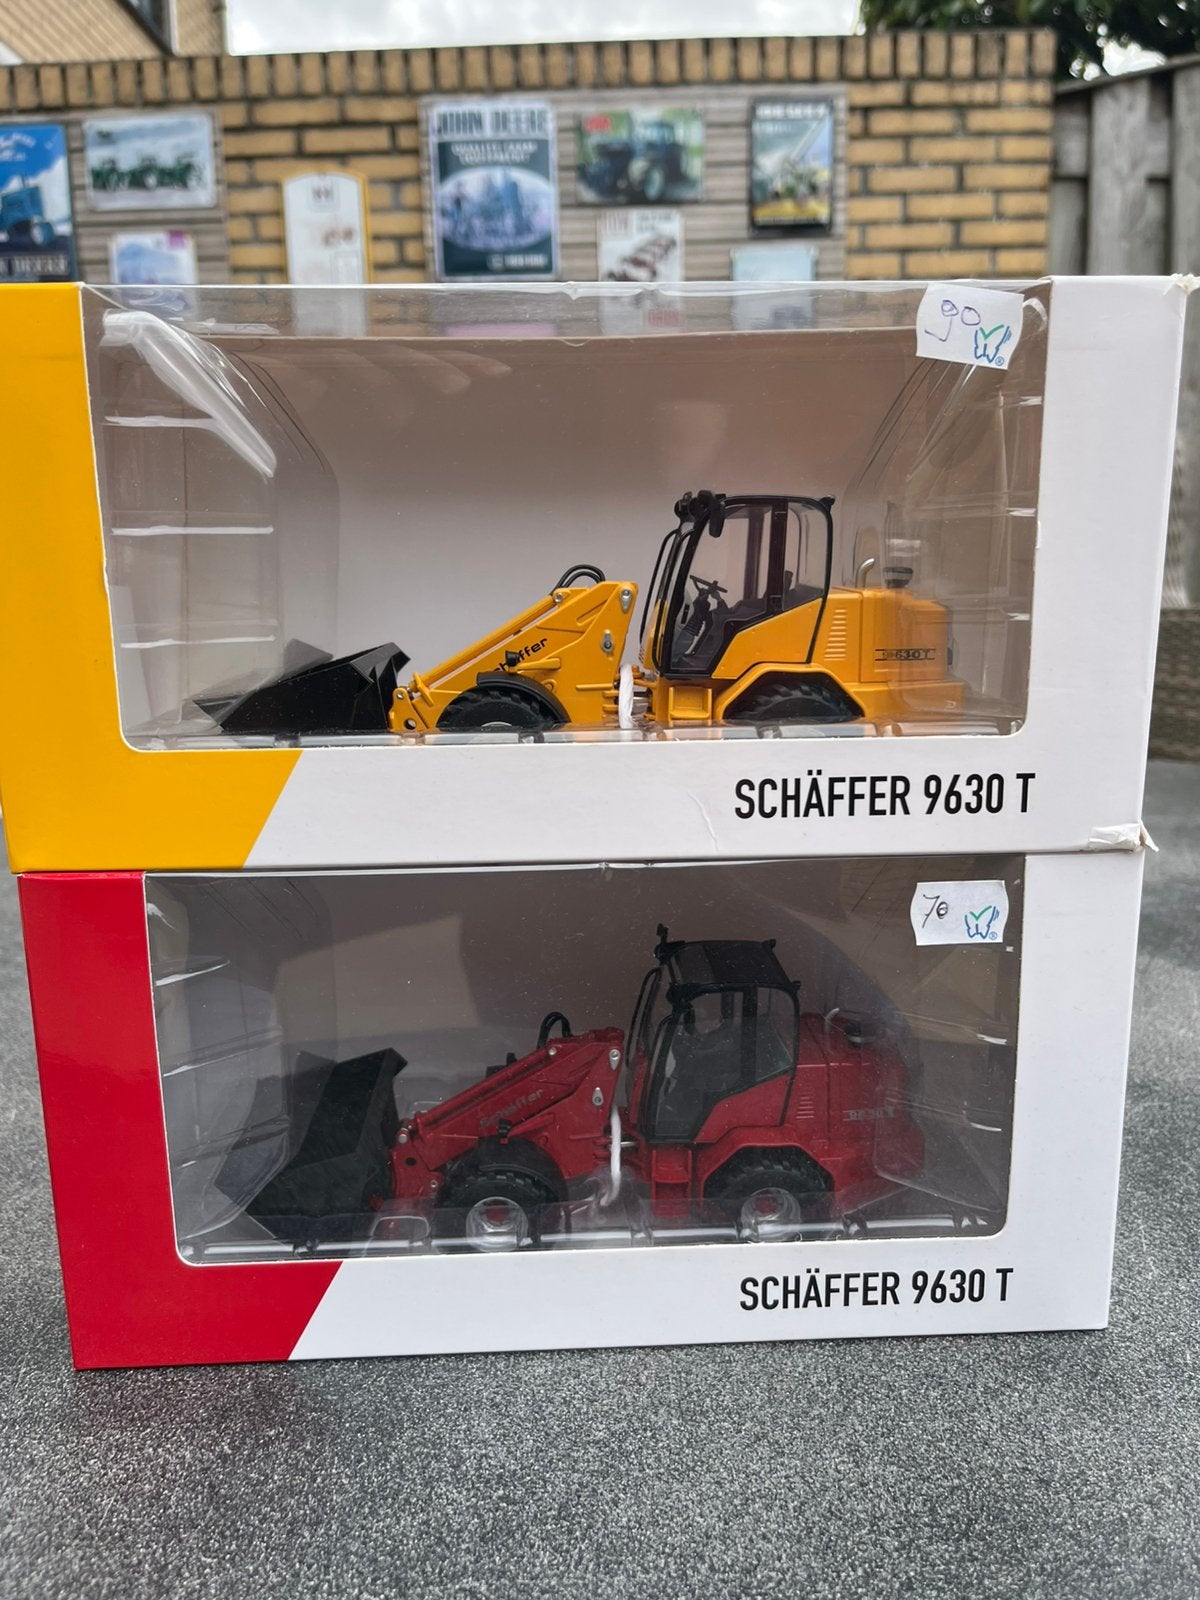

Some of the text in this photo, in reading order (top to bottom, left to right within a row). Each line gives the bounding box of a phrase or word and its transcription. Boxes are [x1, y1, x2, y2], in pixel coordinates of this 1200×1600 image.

[735, 769, 1036, 819] SCHÄFFER 9630 T
[740, 1267, 1014, 1311] SCHÄFFER 9630 T
